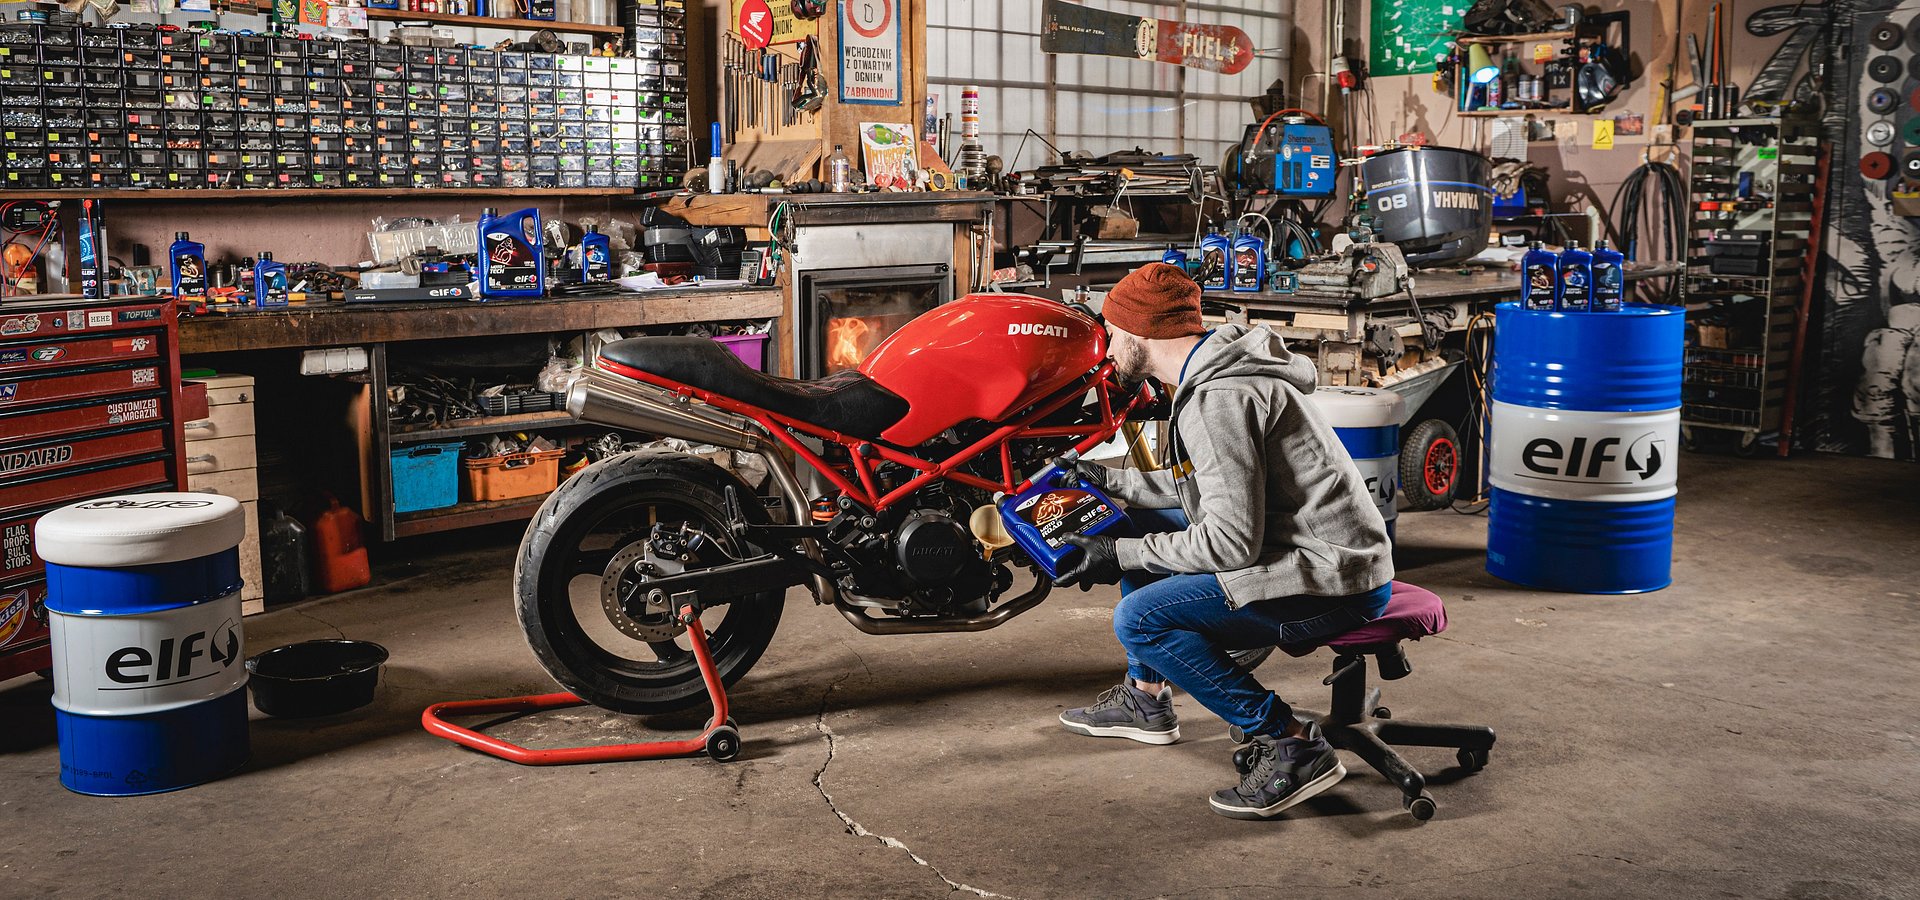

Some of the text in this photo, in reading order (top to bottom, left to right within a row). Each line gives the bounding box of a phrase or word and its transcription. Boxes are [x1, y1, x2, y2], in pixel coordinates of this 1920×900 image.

[845, 46, 892, 59] WCHODZENIE
[1183, 32, 1224, 61] FUEL
[846, 59, 892, 71] Z OTWARTYM
[855, 71, 883, 82] OGNIEM
[845, 86, 894, 98] ZABRONIONE
[1377, 193, 1408, 212] 80
[1432, 191, 1479, 210] YAMAHA
[514, 275, 529, 283] elf
[429, 288, 449, 297] elf
[126, 310, 153, 319] TOPTUL
[1007, 323, 1068, 338] DUCATI
[107, 399, 157, 414] CUSTOMIZED
[122, 408, 158, 422] MAGAZIN
[1522, 437, 1621, 478] elf
[1080, 508, 1097, 523] elf
[5, 524, 26, 538] FLAG
[1041, 520, 1063, 538] ROAD
[3, 534, 30, 549] DROPS
[7, 546, 28, 559] BULL
[5, 554, 32, 570] STOPS
[105, 631, 206, 684] elf
